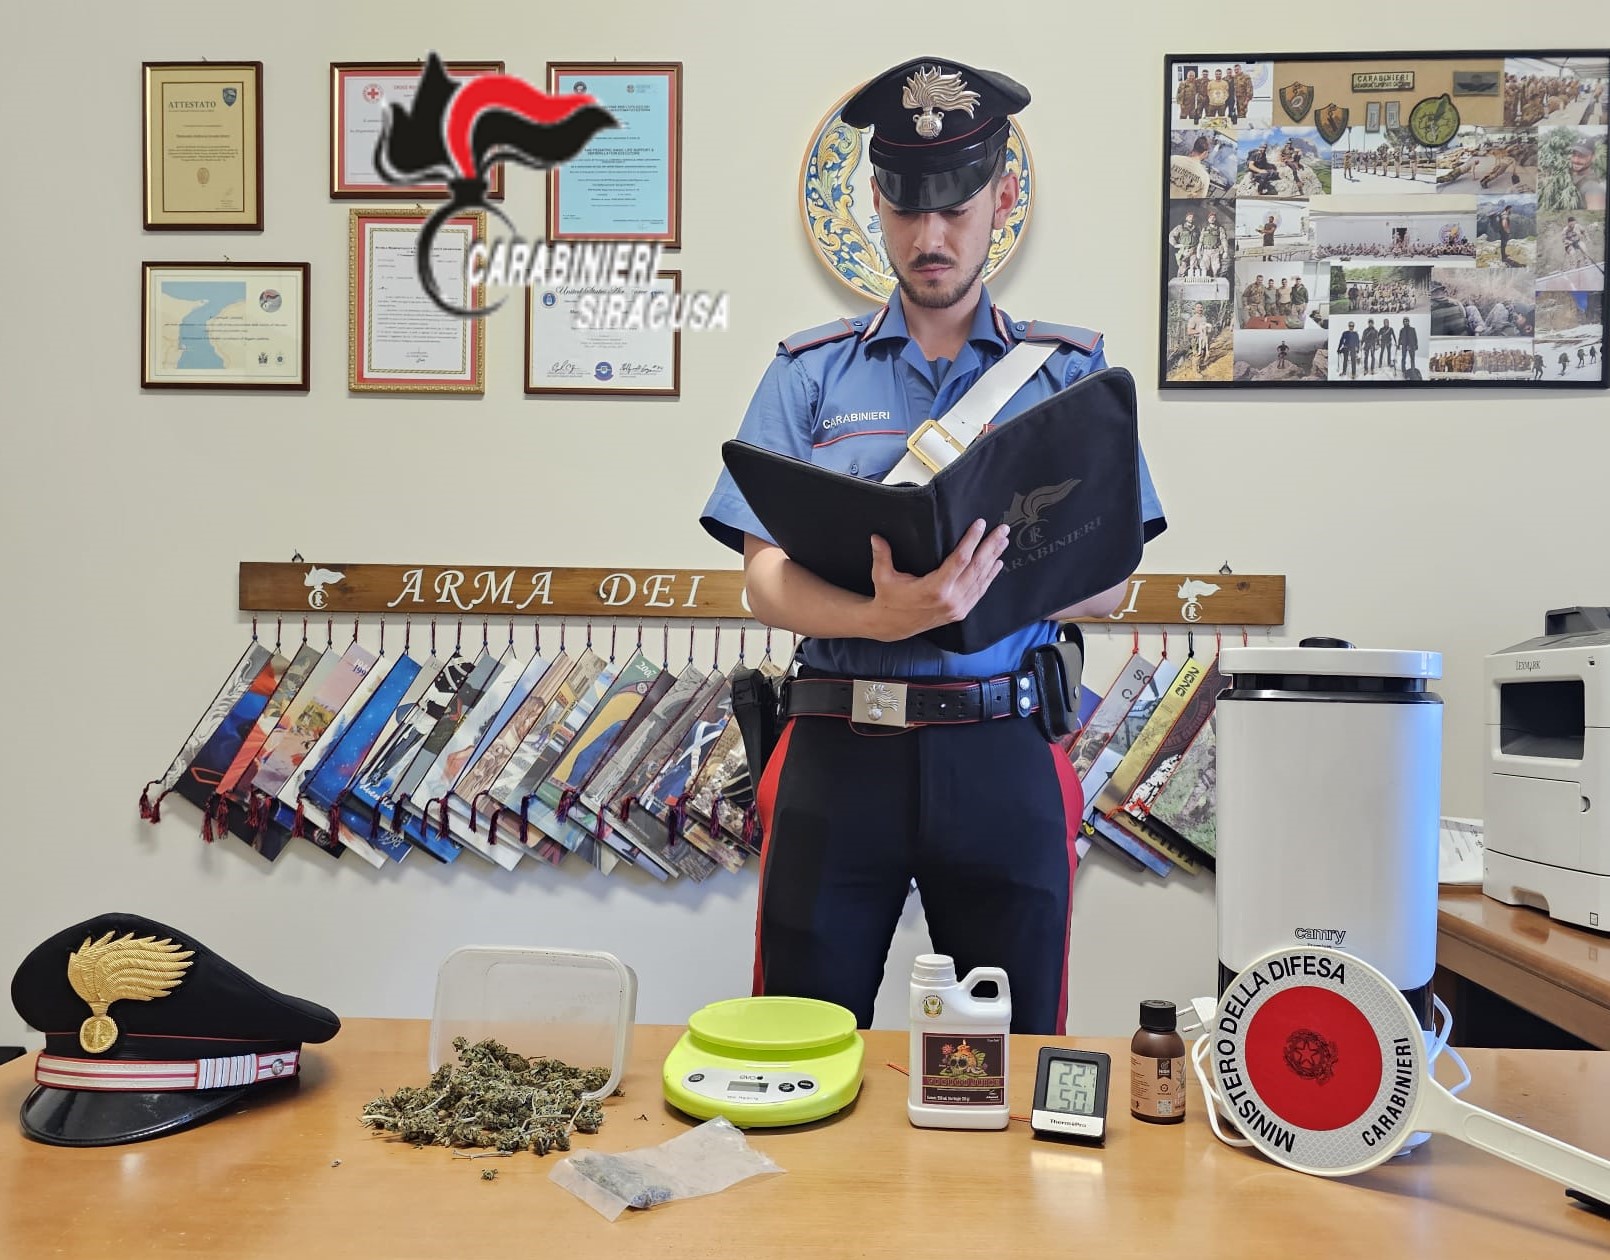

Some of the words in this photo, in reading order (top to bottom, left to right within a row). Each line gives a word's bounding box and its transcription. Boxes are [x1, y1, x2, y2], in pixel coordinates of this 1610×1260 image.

[1357, 74, 1409, 83] CARABINIERI
[168, 101, 217, 109] ATTESTATO
[822, 411, 890, 430] CARABINIERI
[1003, 516, 1103, 573] ARABINIERI
[387, 568, 554, 610] ARMA
[599, 573, 705, 608] DEI
[1294, 927, 1346, 945] camry
[1268, 955, 1346, 985] DIFESA
[1219, 971, 1269, 1035] DELLA
[1217, 1039, 1296, 1153] MINISTERO
[1361, 1037, 1412, 1147] CARABINIERI
[1050, 1118, 1087, 1128] ThermoPro
